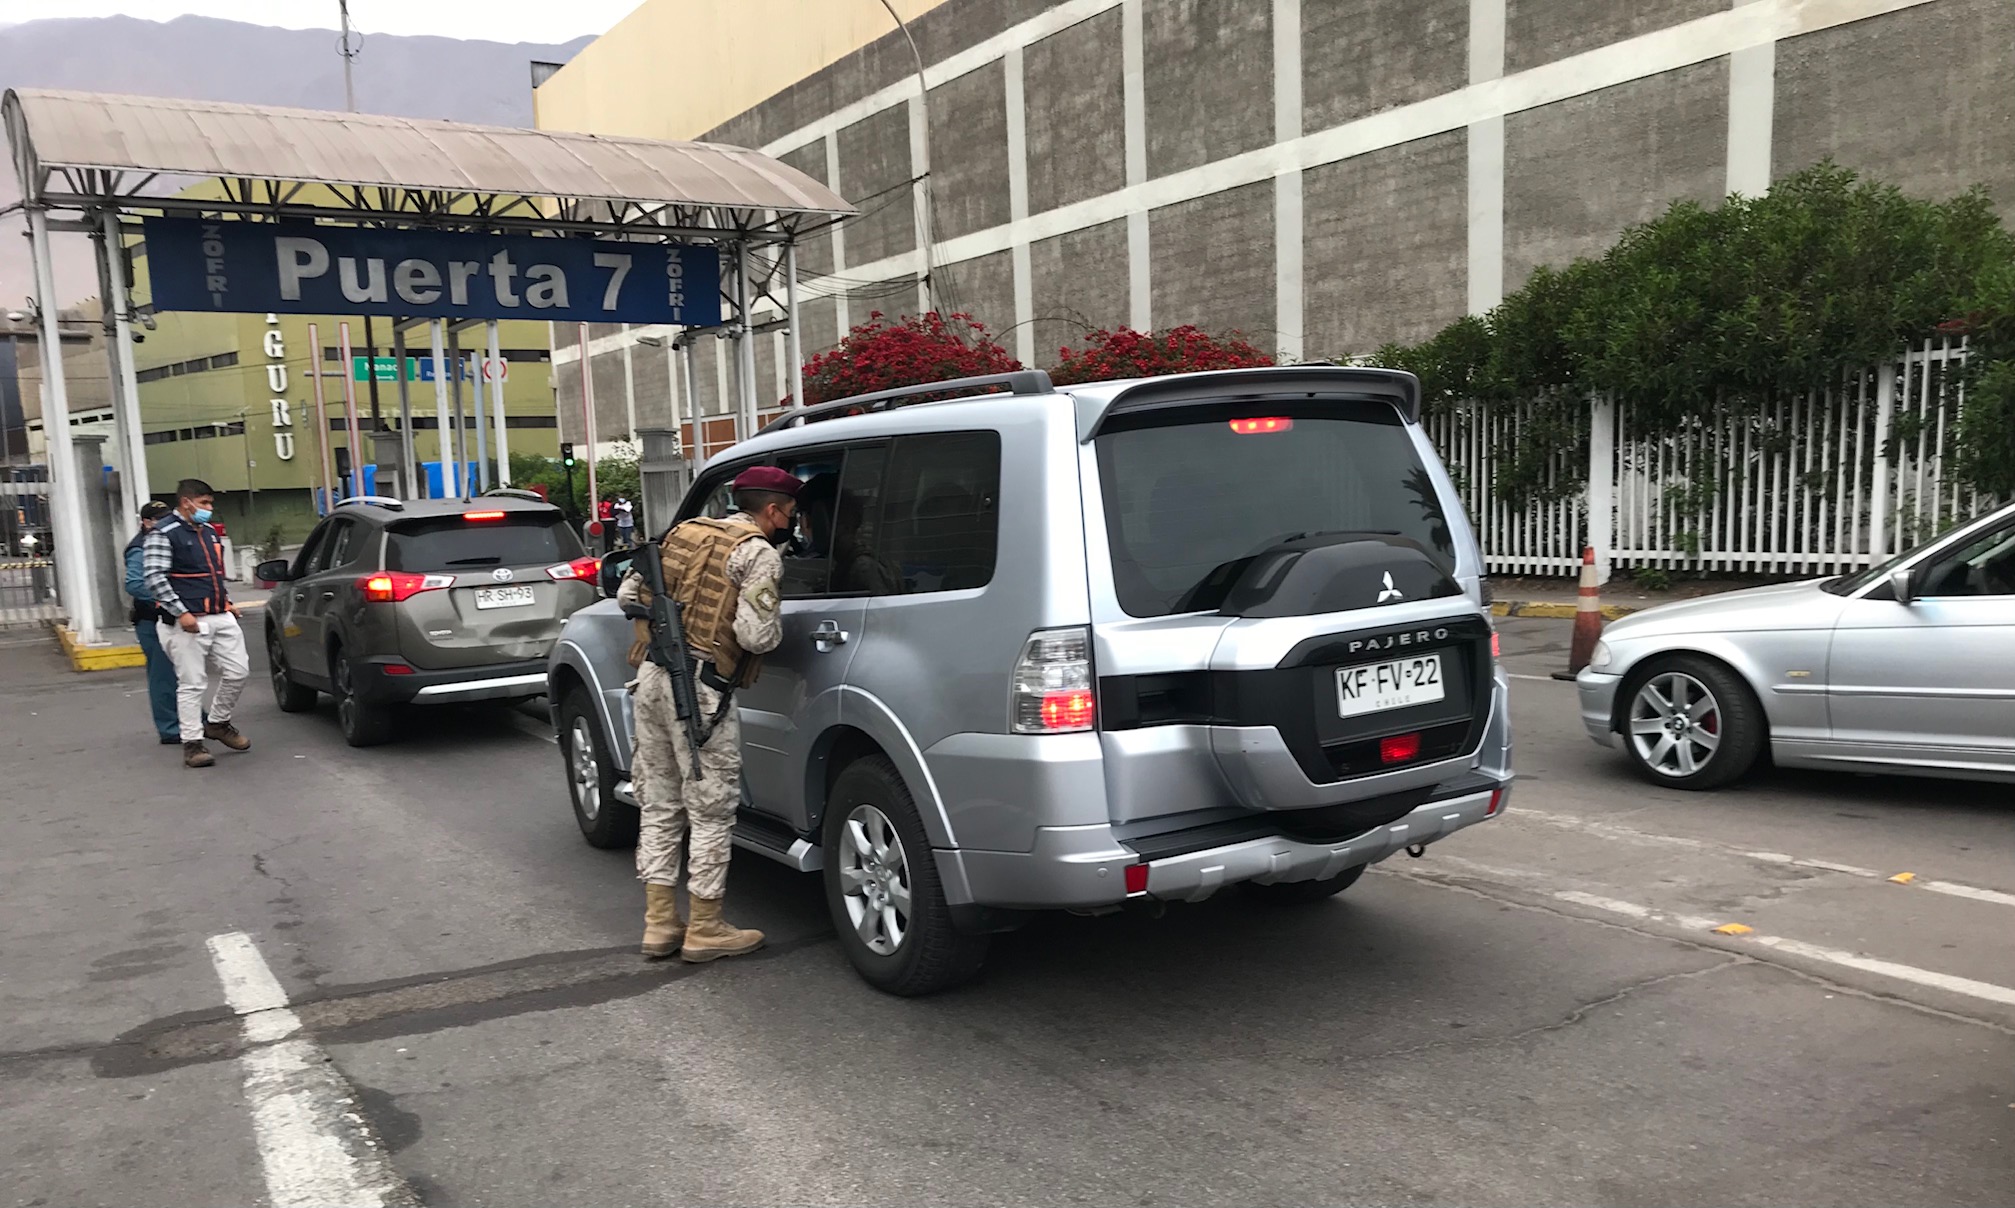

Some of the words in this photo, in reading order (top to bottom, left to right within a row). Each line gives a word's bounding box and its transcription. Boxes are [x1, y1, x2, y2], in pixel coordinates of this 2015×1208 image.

[201, 224, 229, 308] ZOFRI
[274, 236, 571, 309] Puerta
[593, 252, 633, 311] 7
[666, 248, 685, 321] ZOFRI
[1348, 628, 1448, 653] PAJERO
